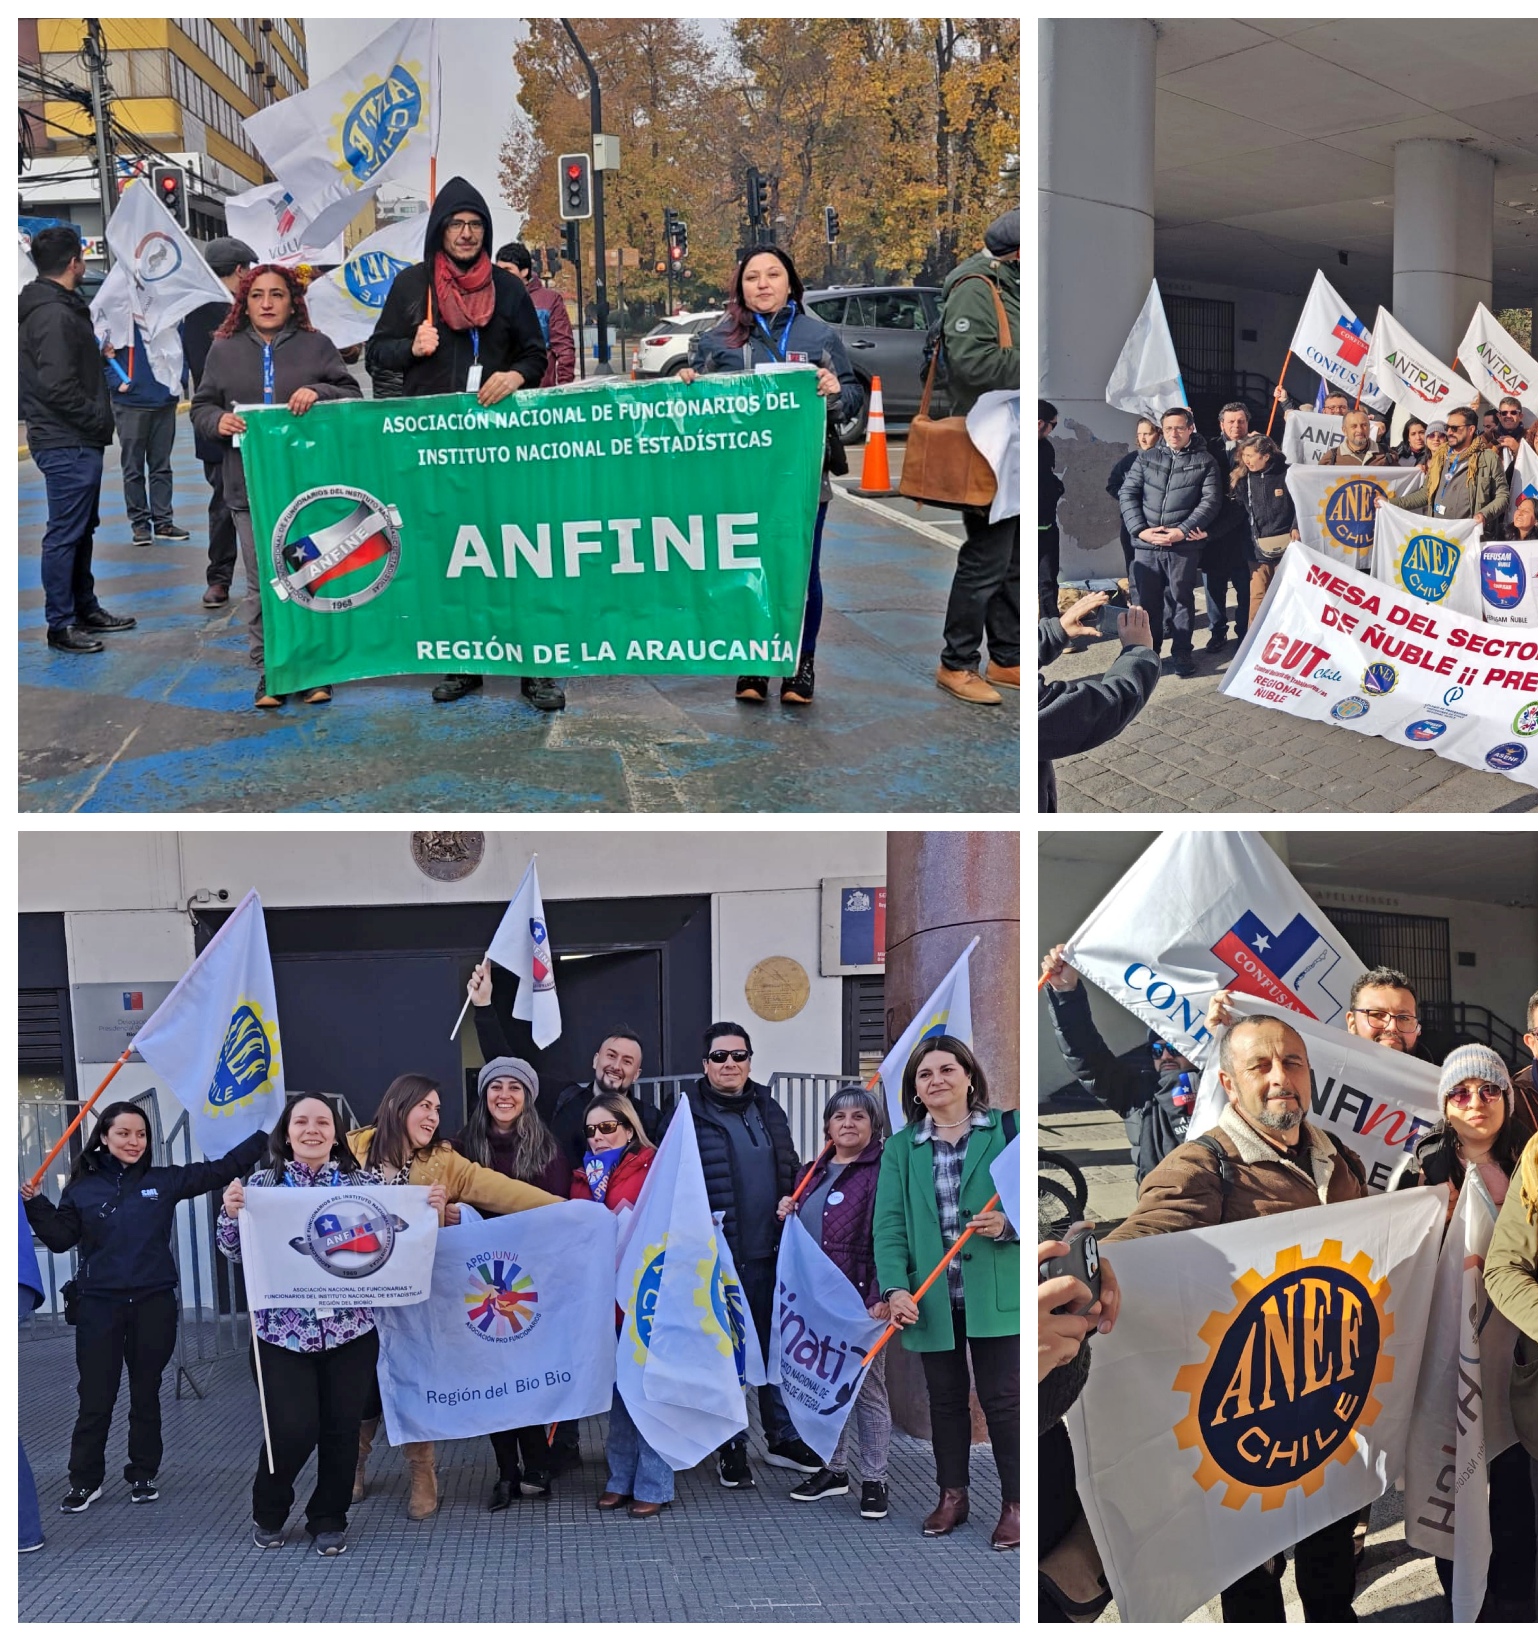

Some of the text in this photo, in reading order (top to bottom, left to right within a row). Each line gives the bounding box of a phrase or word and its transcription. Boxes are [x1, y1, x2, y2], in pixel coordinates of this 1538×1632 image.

[1306, 346, 1380, 397] CONFUSAM
[1385, 351, 1450, 399] ANTRAP
[1476, 341, 1529, 394] ANTRAP
[382, 391, 800, 434] ASOCIACIÓN NACIONAL DE FUNCIONARIOS DEL
[417, 429, 773, 466] INSTITUTO NACIONAL DE ESTADÍSTICAS
[308, 527, 369, 577] ANFINE
[446, 512, 762, 579] ANFINE
[1405, 538, 1457, 577] ANEF
[1483, 552, 1512, 561] FEFUSAM
[1305, 564, 1380, 616] MESA
[1385, 601, 1440, 641] DEL
[1409, 573, 1449, 598] CHILE
[416, 633, 794, 664] REGIÓN DE LA ARAUCANÍA
[1260, 631, 1332, 678] CUT
[1320, 603, 1358, 636] DE
[1360, 624, 1464, 677] ÑUBLE
[1253, 675, 1302, 698] REGIONAL
[1313, 668, 1343, 683] Chile
[1253, 689, 1288, 704] ÑUBLE
[326, 1222, 373, 1247] ANFINE
[465, 1250, 519, 1271] APROJUNJI
[465, 1312, 542, 1344] ASOCIACIÓN PRO FUNCIONARIOS
[1211, 1277, 1364, 1427] ANEF
[427, 1370, 572, 1407] Región del Bio Bio
[1236, 1391, 1360, 1470] CHILE
